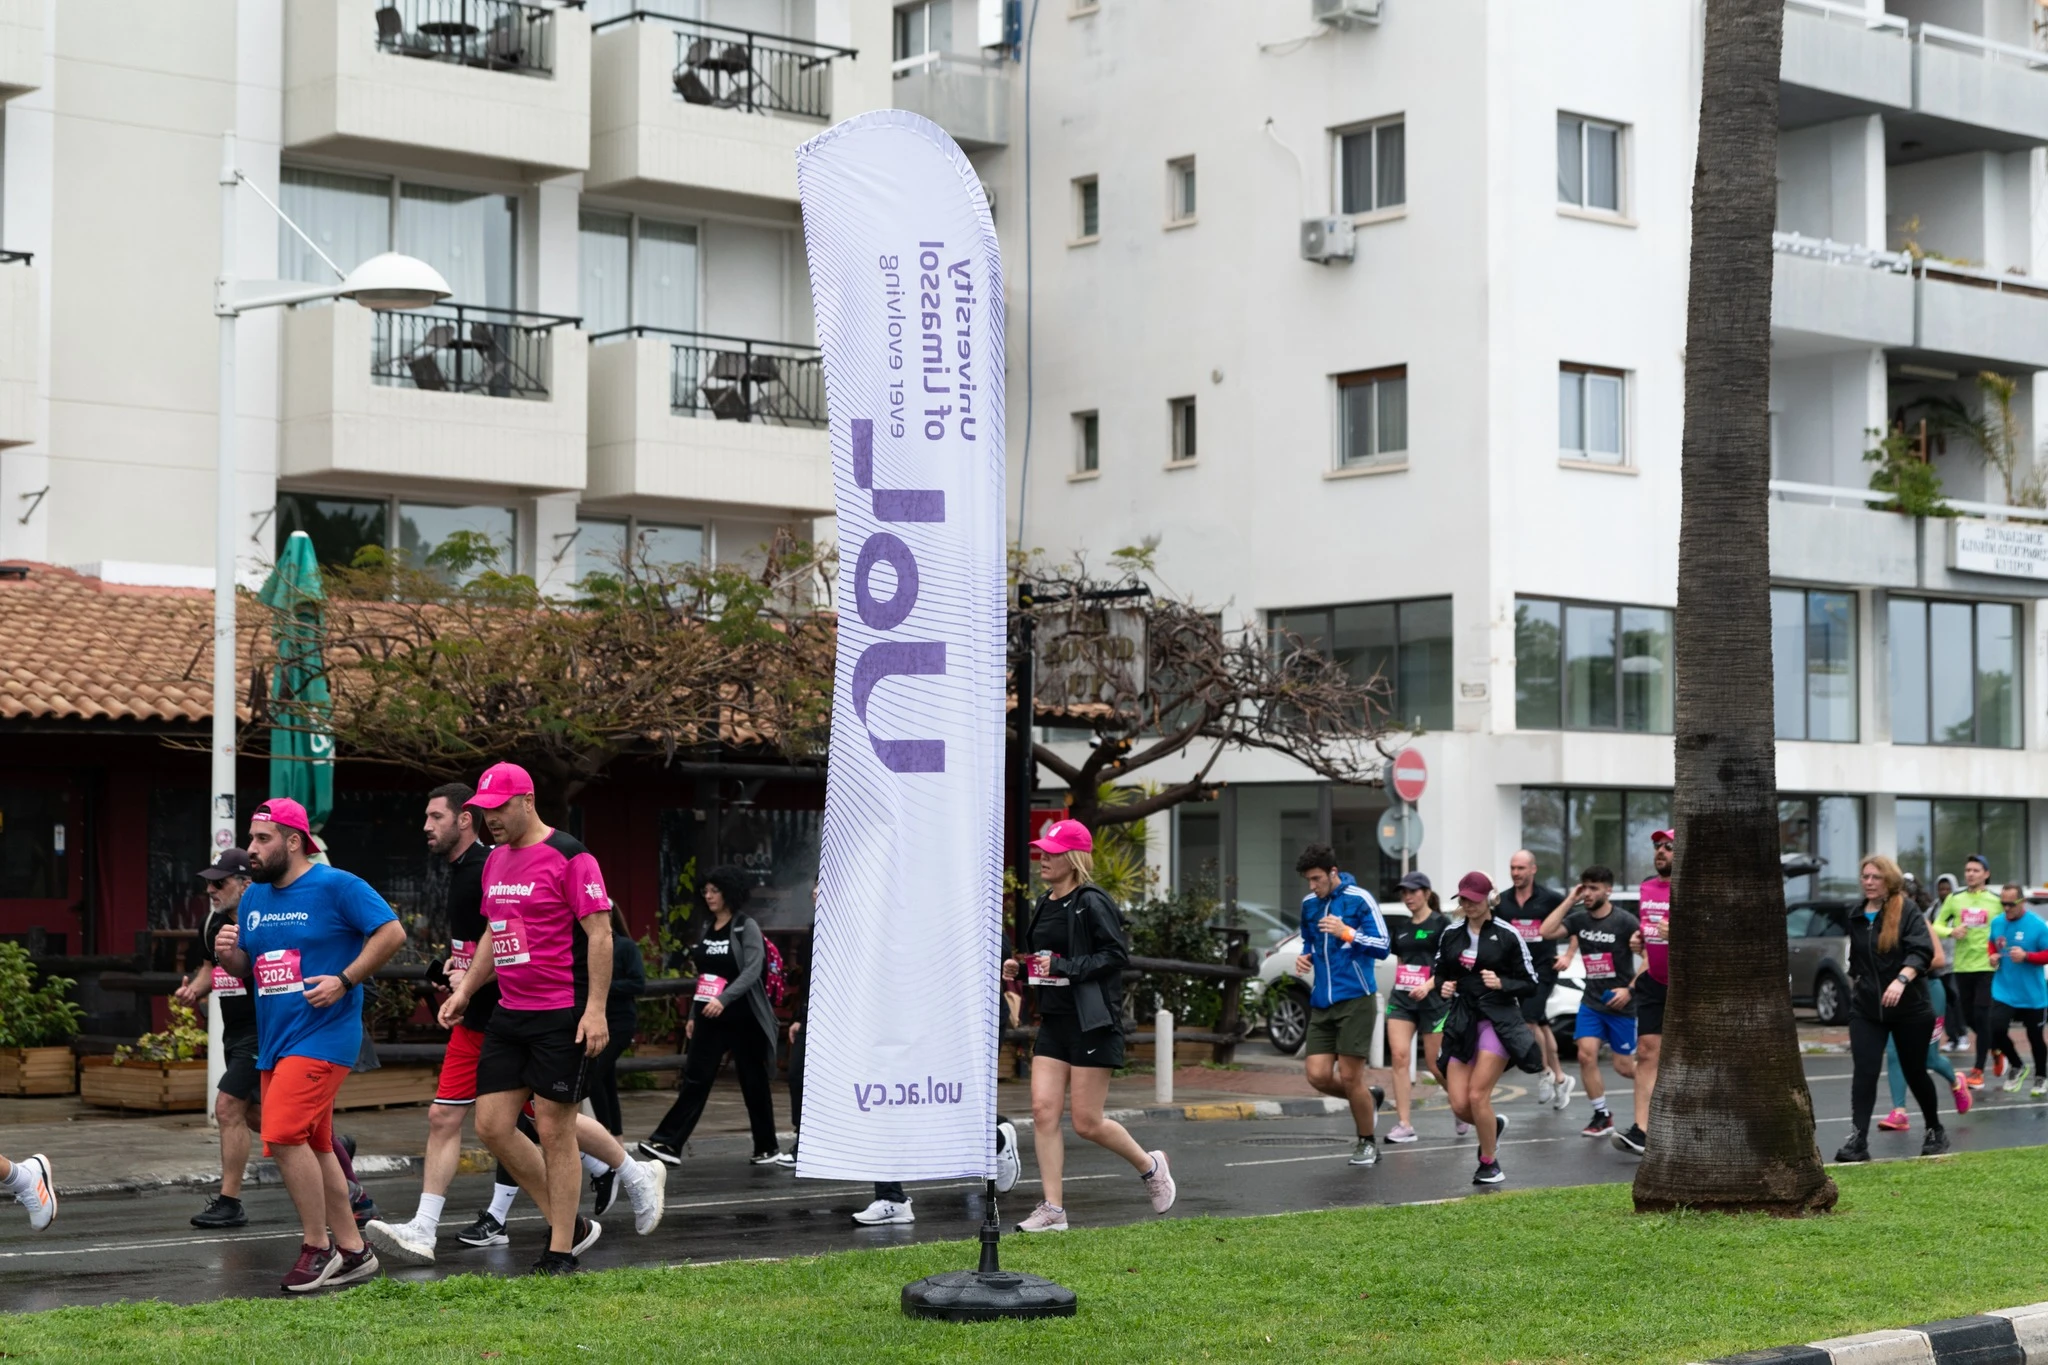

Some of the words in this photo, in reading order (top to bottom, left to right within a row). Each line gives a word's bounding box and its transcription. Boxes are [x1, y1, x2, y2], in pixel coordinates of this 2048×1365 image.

[488, 881, 536, 898] primetel
[493, 938, 521, 954] 0213
[706, 945, 729, 955] RSM
[497, 955, 516, 965] primetel
